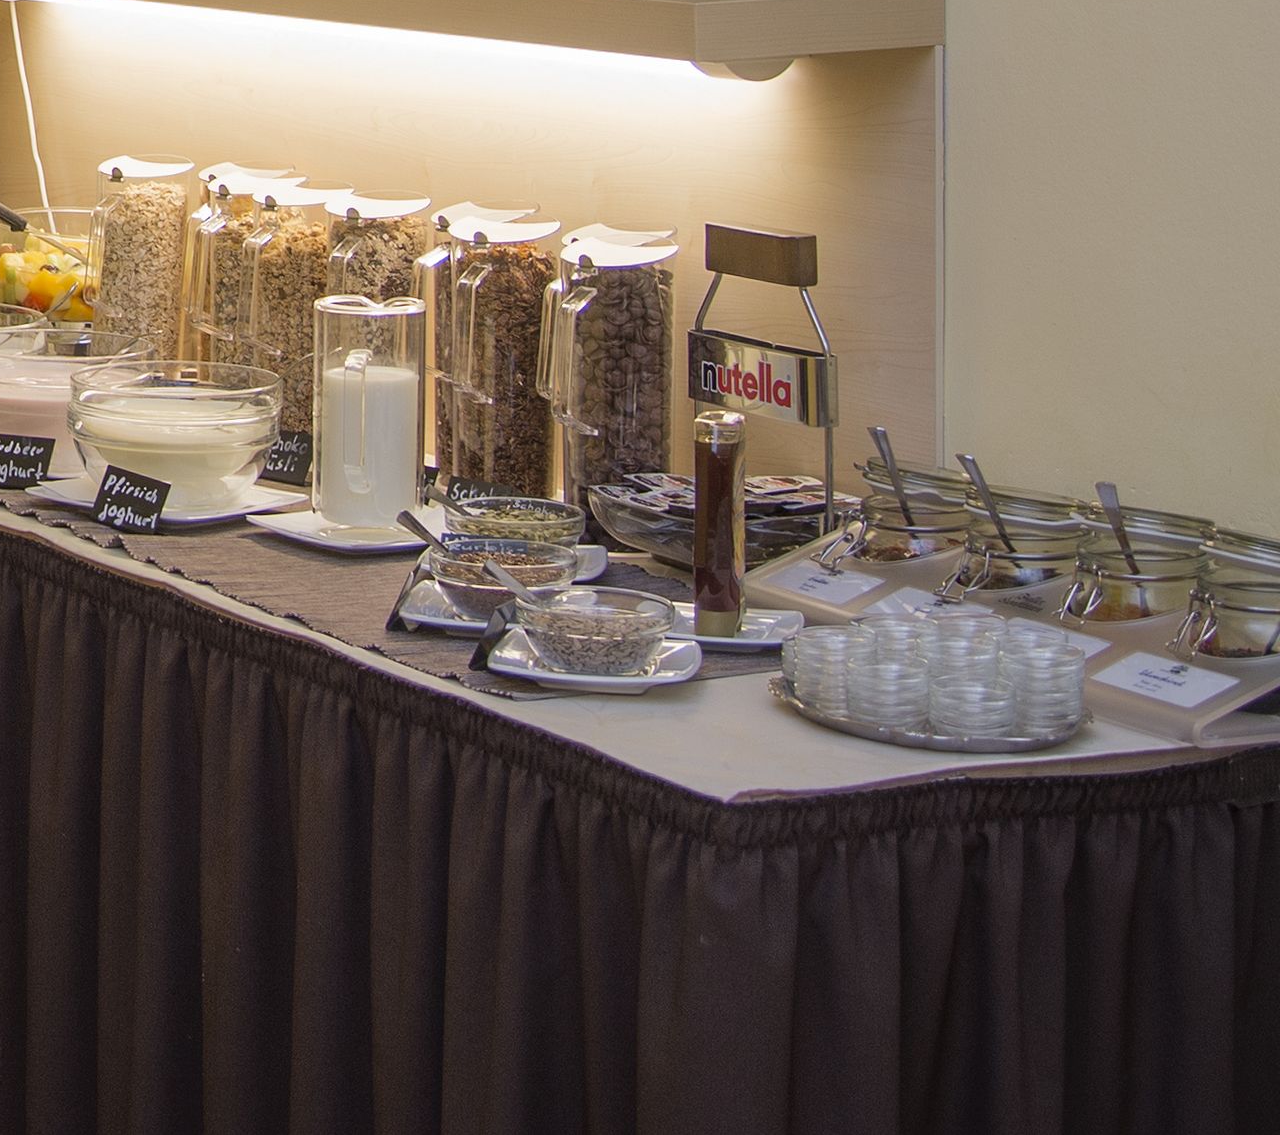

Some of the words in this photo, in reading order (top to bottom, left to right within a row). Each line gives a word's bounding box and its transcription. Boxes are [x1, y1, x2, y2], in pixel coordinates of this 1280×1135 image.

[701, 359, 793, 409] nutella
[104, 474, 159, 505] Pfirsich
[98, 498, 158, 530] joghurt
